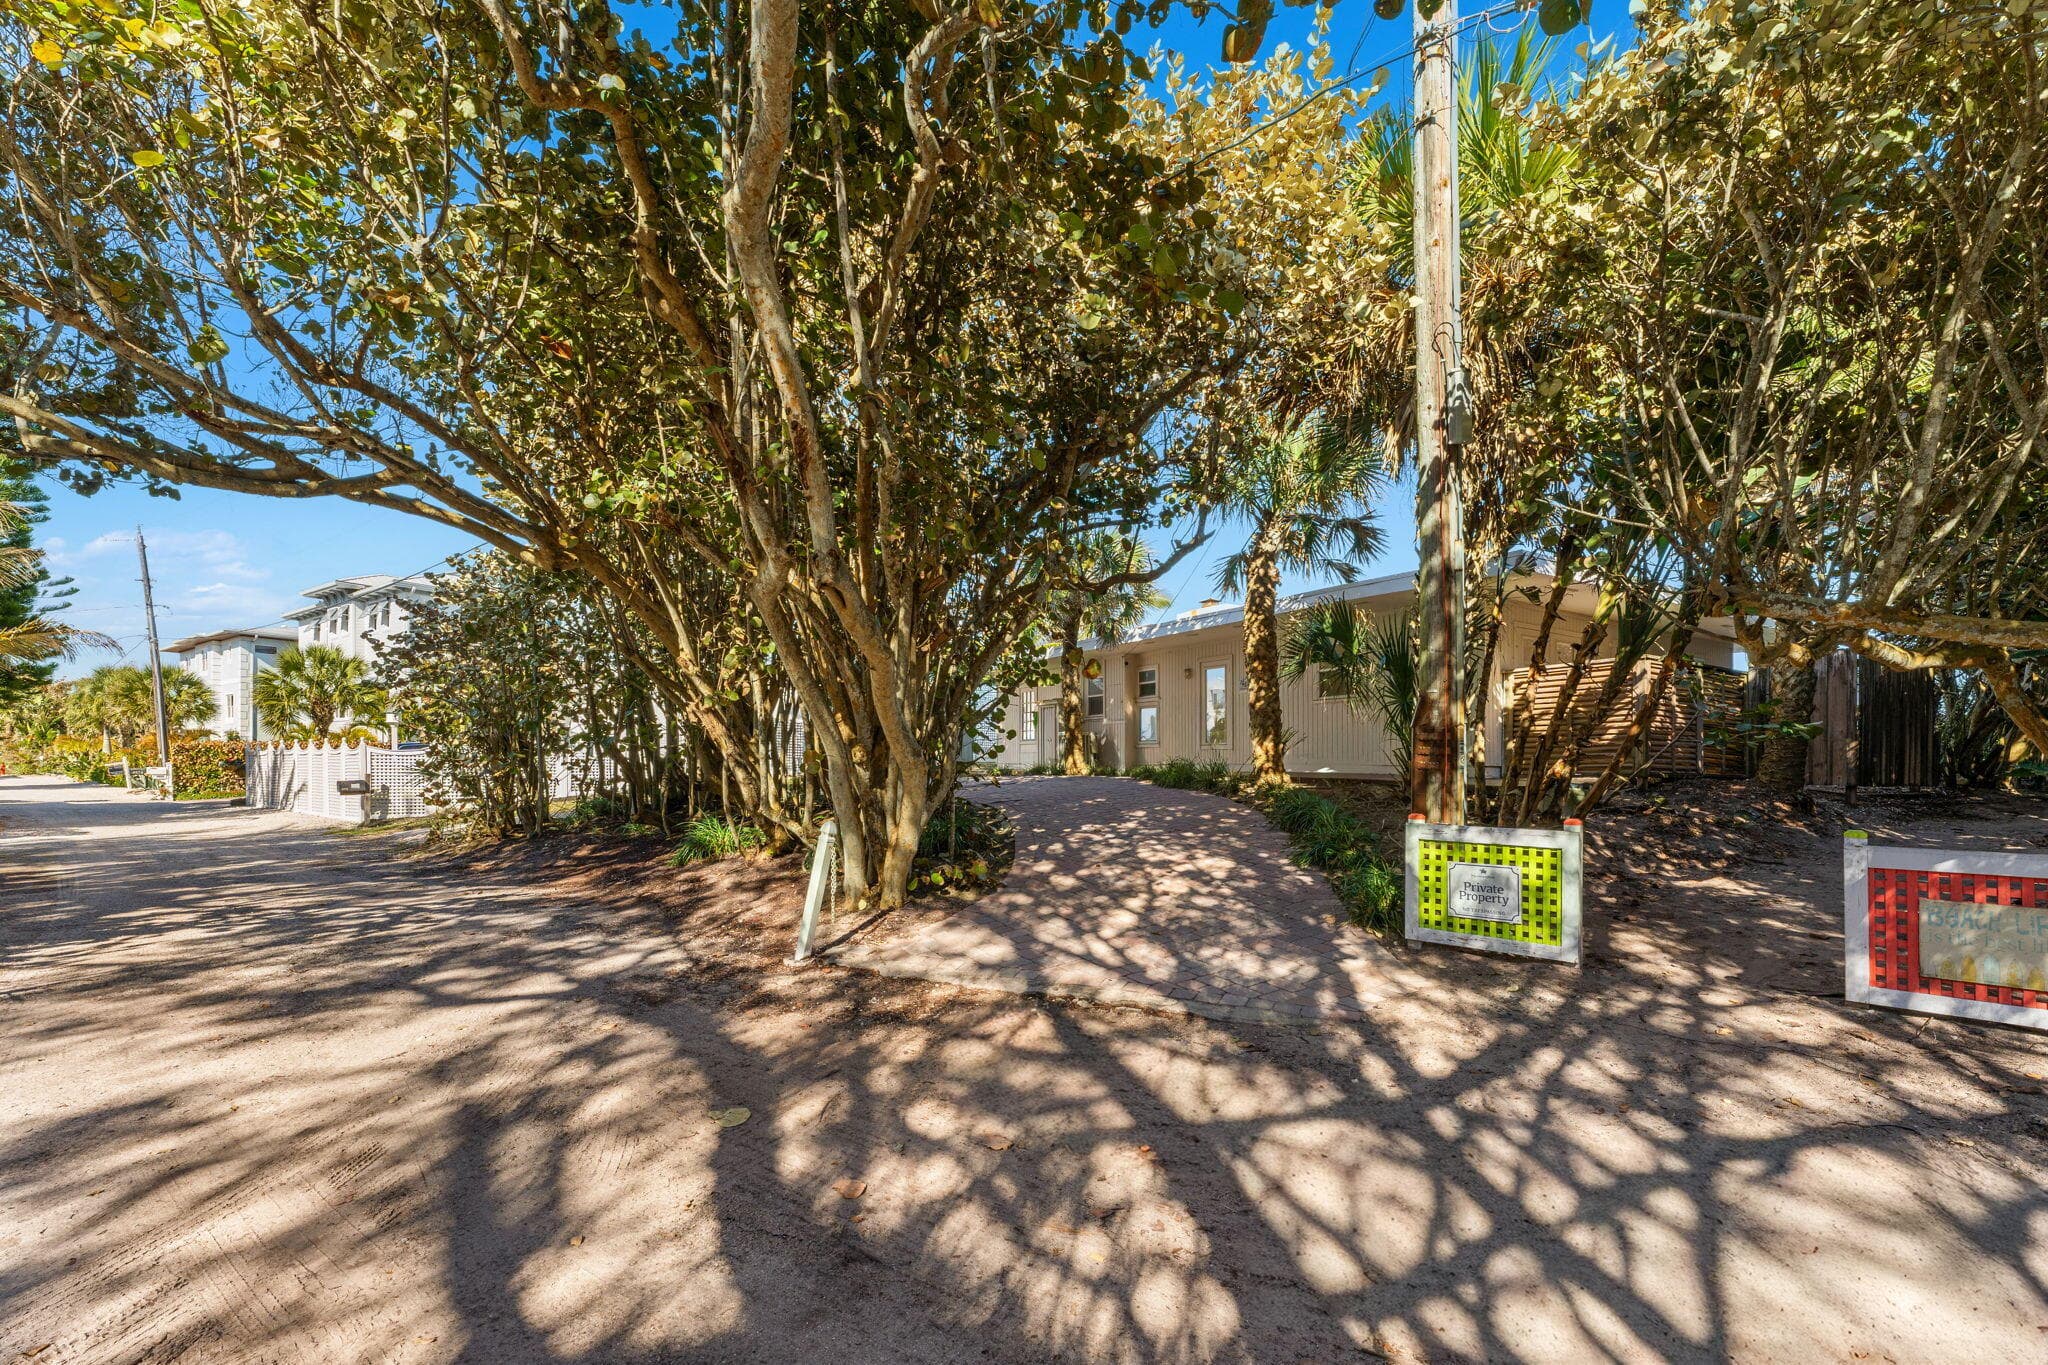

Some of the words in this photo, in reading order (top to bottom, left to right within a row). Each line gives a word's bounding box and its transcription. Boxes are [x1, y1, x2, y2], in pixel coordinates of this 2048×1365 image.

[1463, 881, 1504, 894] Private
[1459, 890, 1509, 906] Property
[1927, 905, 2001, 932] BEACH
